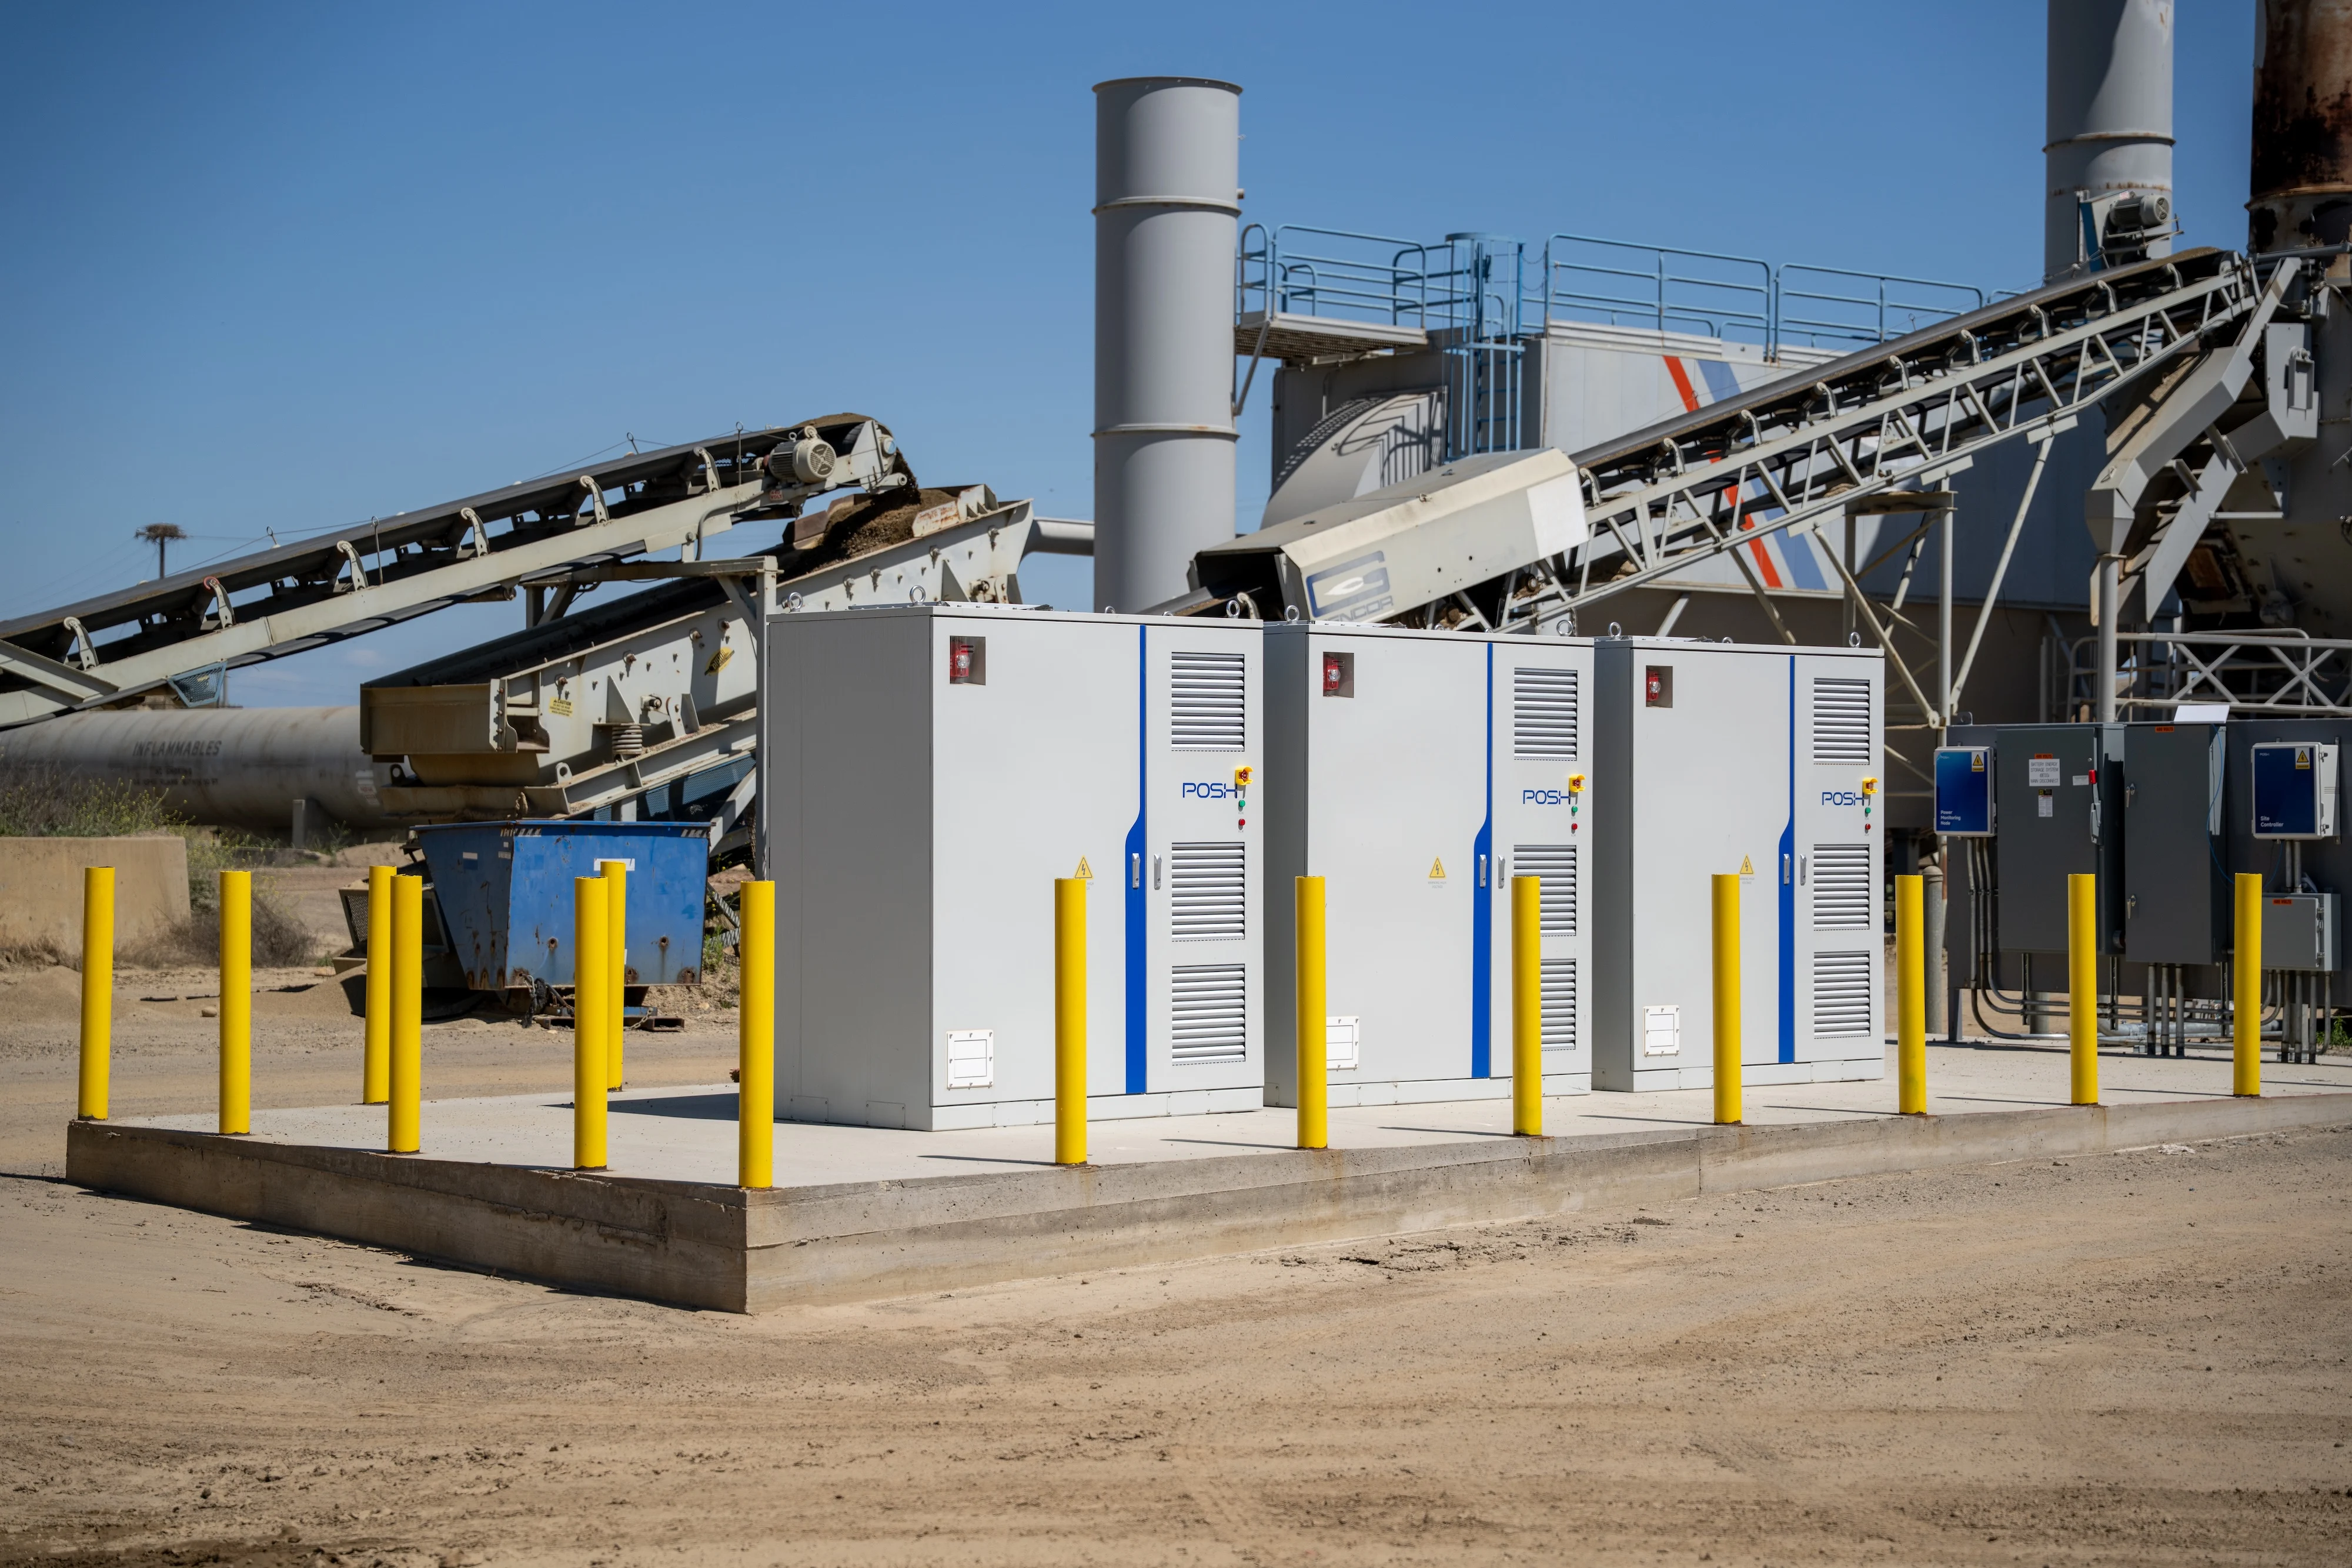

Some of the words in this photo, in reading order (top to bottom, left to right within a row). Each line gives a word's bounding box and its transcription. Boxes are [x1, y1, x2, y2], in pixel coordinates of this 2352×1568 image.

[1324, 595, 1394, 621] ENCOR
[133, 740, 222, 756] INFLAMMABLES
[1183, 783, 1237, 799] POSH
[1523, 790, 1570, 804] POSH
[1822, 792, 1864, 806] POSH
